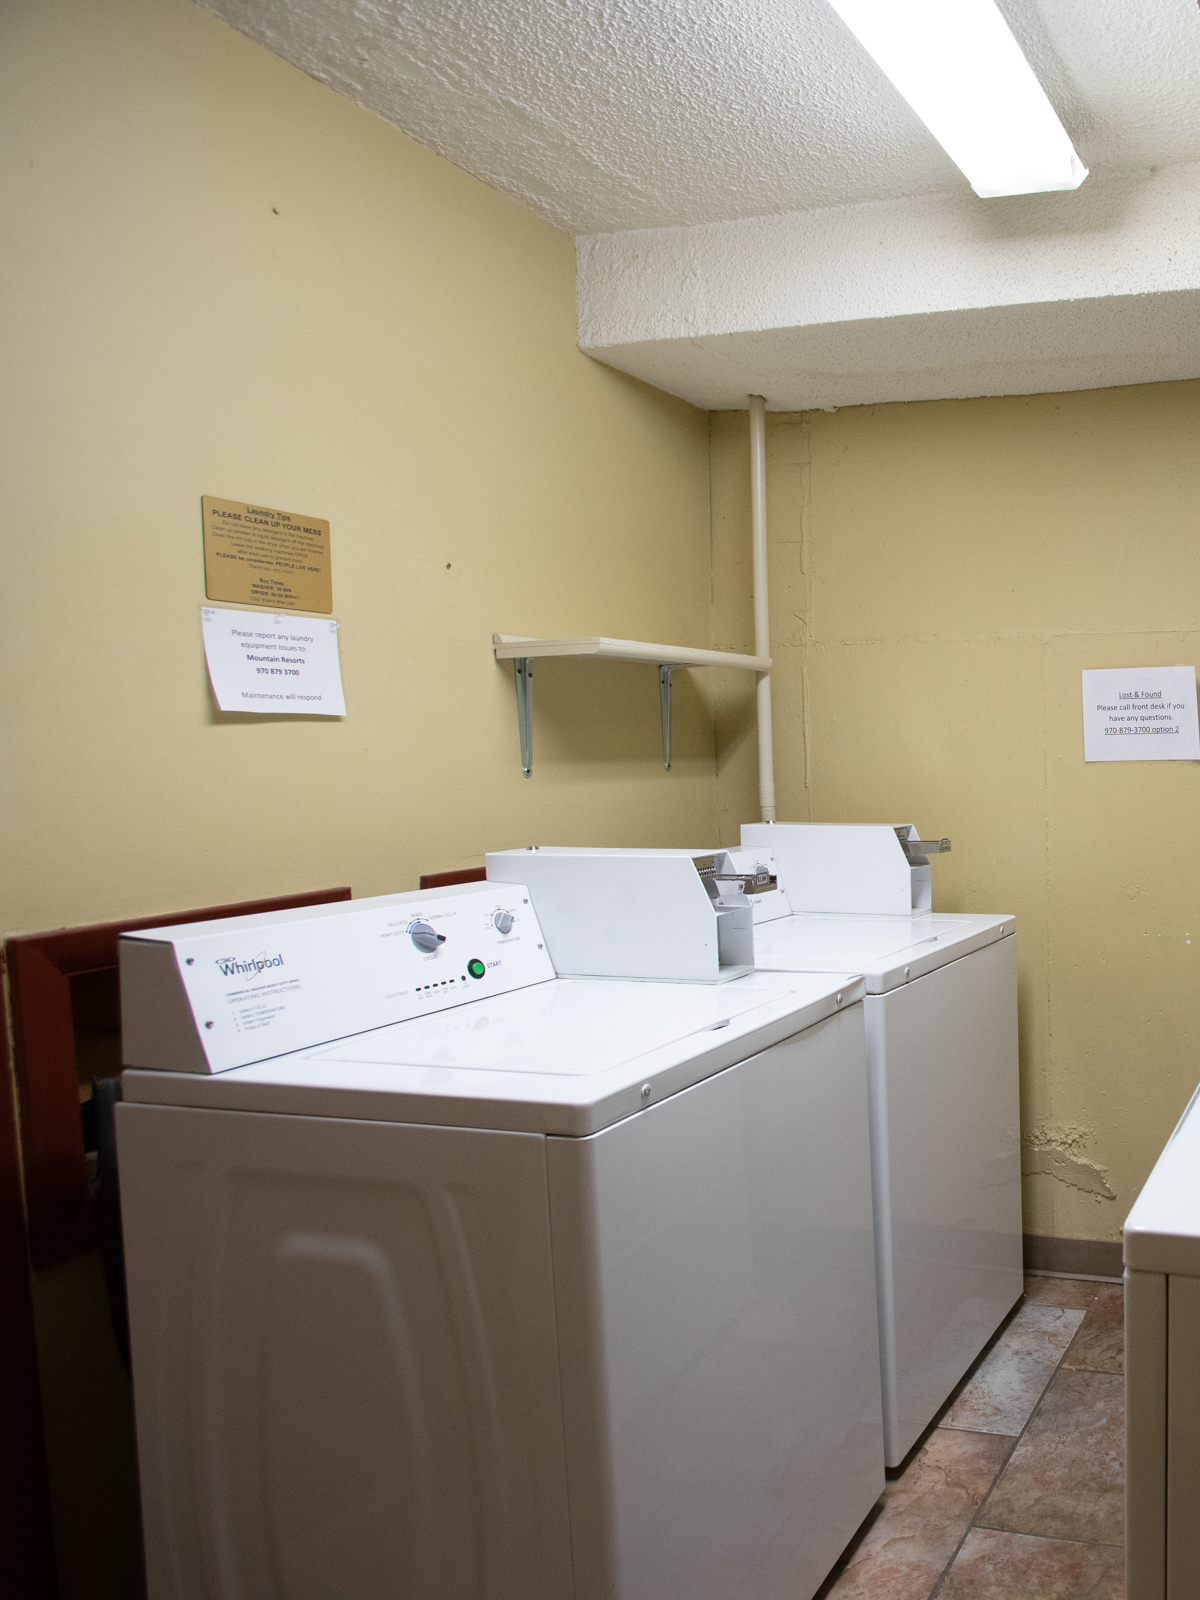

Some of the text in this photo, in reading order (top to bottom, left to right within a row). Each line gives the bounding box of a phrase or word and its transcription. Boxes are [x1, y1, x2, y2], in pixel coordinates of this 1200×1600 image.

[247, 507, 291, 521] Laundry Tips
[212, 509, 243, 521] PLEASE
[244, 515, 269, 525] CLEAN
[282, 522, 302, 532] YOUR
[303, 527, 322, 536] MESS
[216, 551, 237, 559] PLEASE
[276, 561, 295, 569] PEOPLE
[231, 629, 254, 638] Please
[255, 632, 276, 640] report
[290, 634, 314, 643] laundry
[240, 642, 277, 650] equipment
[278, 644, 298, 652] issues
[246, 654, 305, 664] Mountain Resorts
[241, 691, 284, 700] Maintenance
[297, 694, 322, 702] respond
[1118, 691, 1133, 699] Lost
[1141, 690, 1162, 698] Found
[1150, 702, 1165, 710] desk
[1139, 714, 1174, 722] questions.
[1104, 725, 1180, 735] 970-879-3700 option 2
[388, 920, 408, 928] DELICATES
[219, 953, 284, 976] Whirlpool
[487, 960, 502, 969] START
[228, 984, 301, 1004] OPERATING INSTRUCTIONS
[255, 1005, 285, 1016] TEMPERATURE
